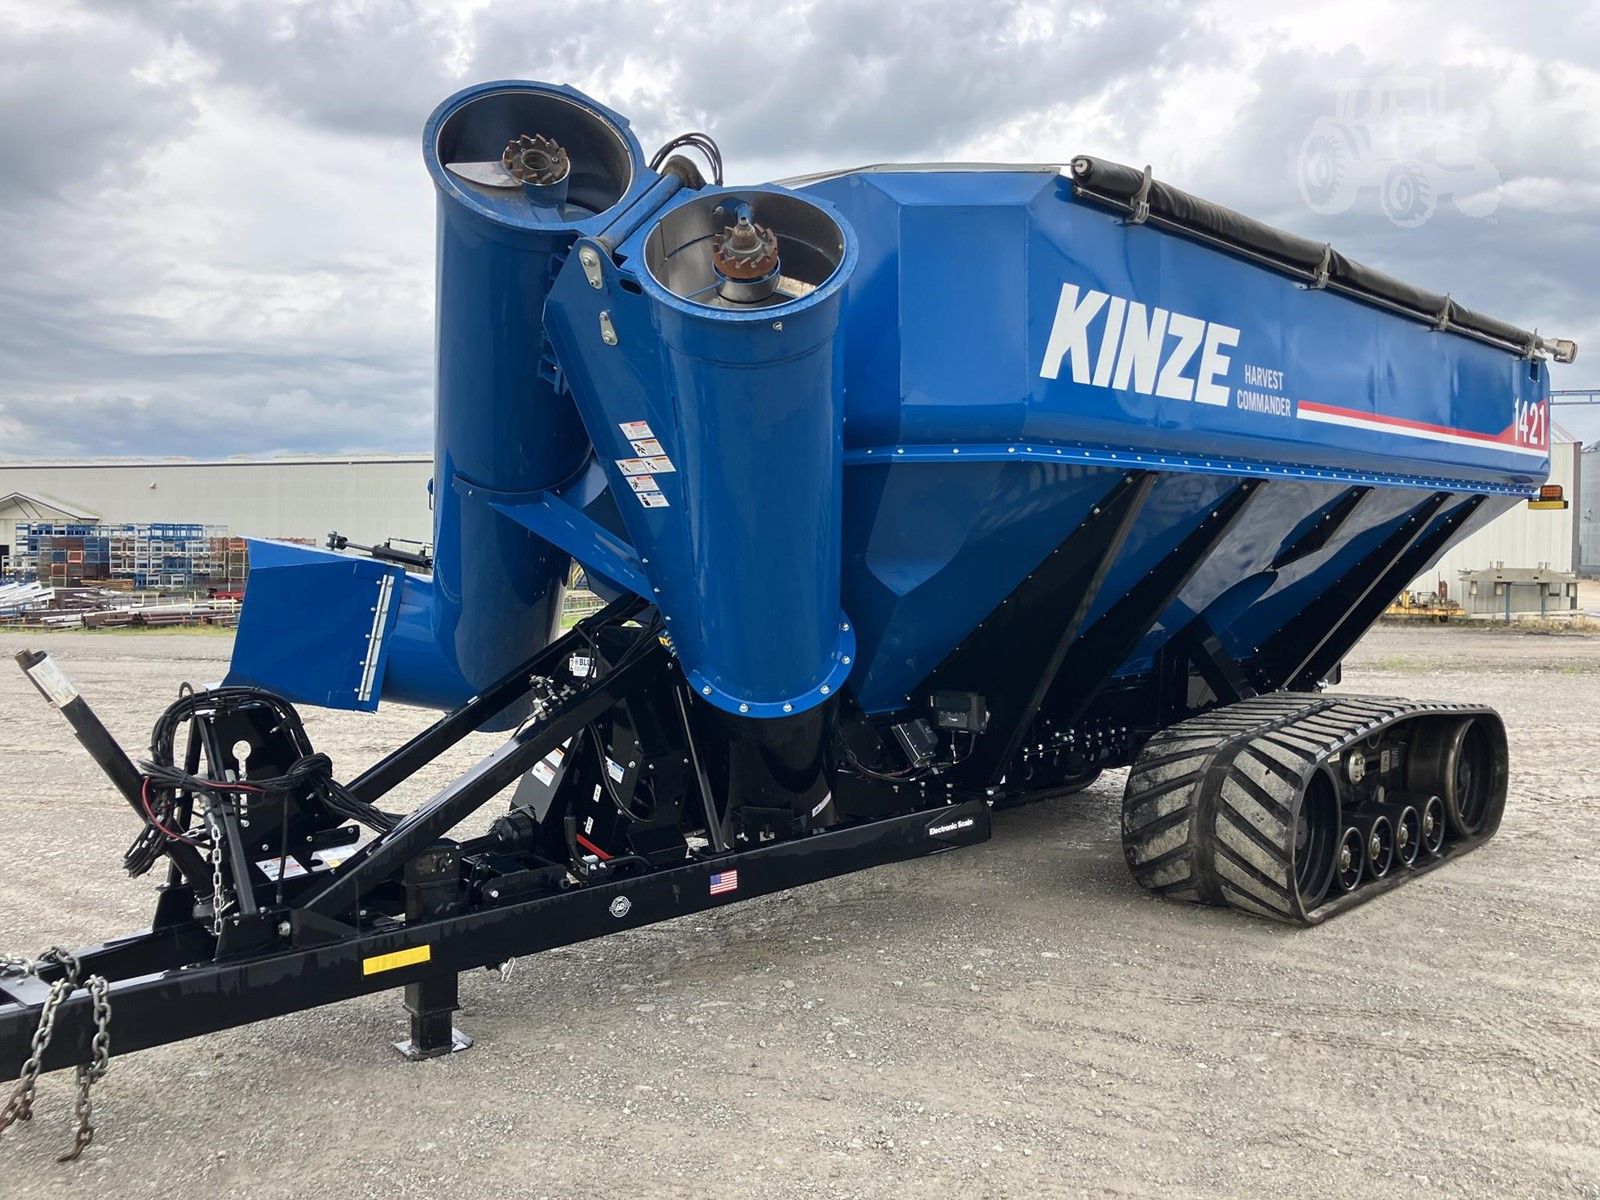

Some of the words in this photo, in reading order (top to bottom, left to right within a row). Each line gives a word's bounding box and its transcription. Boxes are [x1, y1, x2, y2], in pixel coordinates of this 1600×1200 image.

[1039, 282, 1241, 407] KINZE
[1244, 364, 1284, 390] HARVEST
[1237, 389, 1291, 417] COMMANDER
[1514, 397, 1545, 446] 1421
[929, 823, 957, 835] Electronic
[957, 819, 973, 828] Scale
